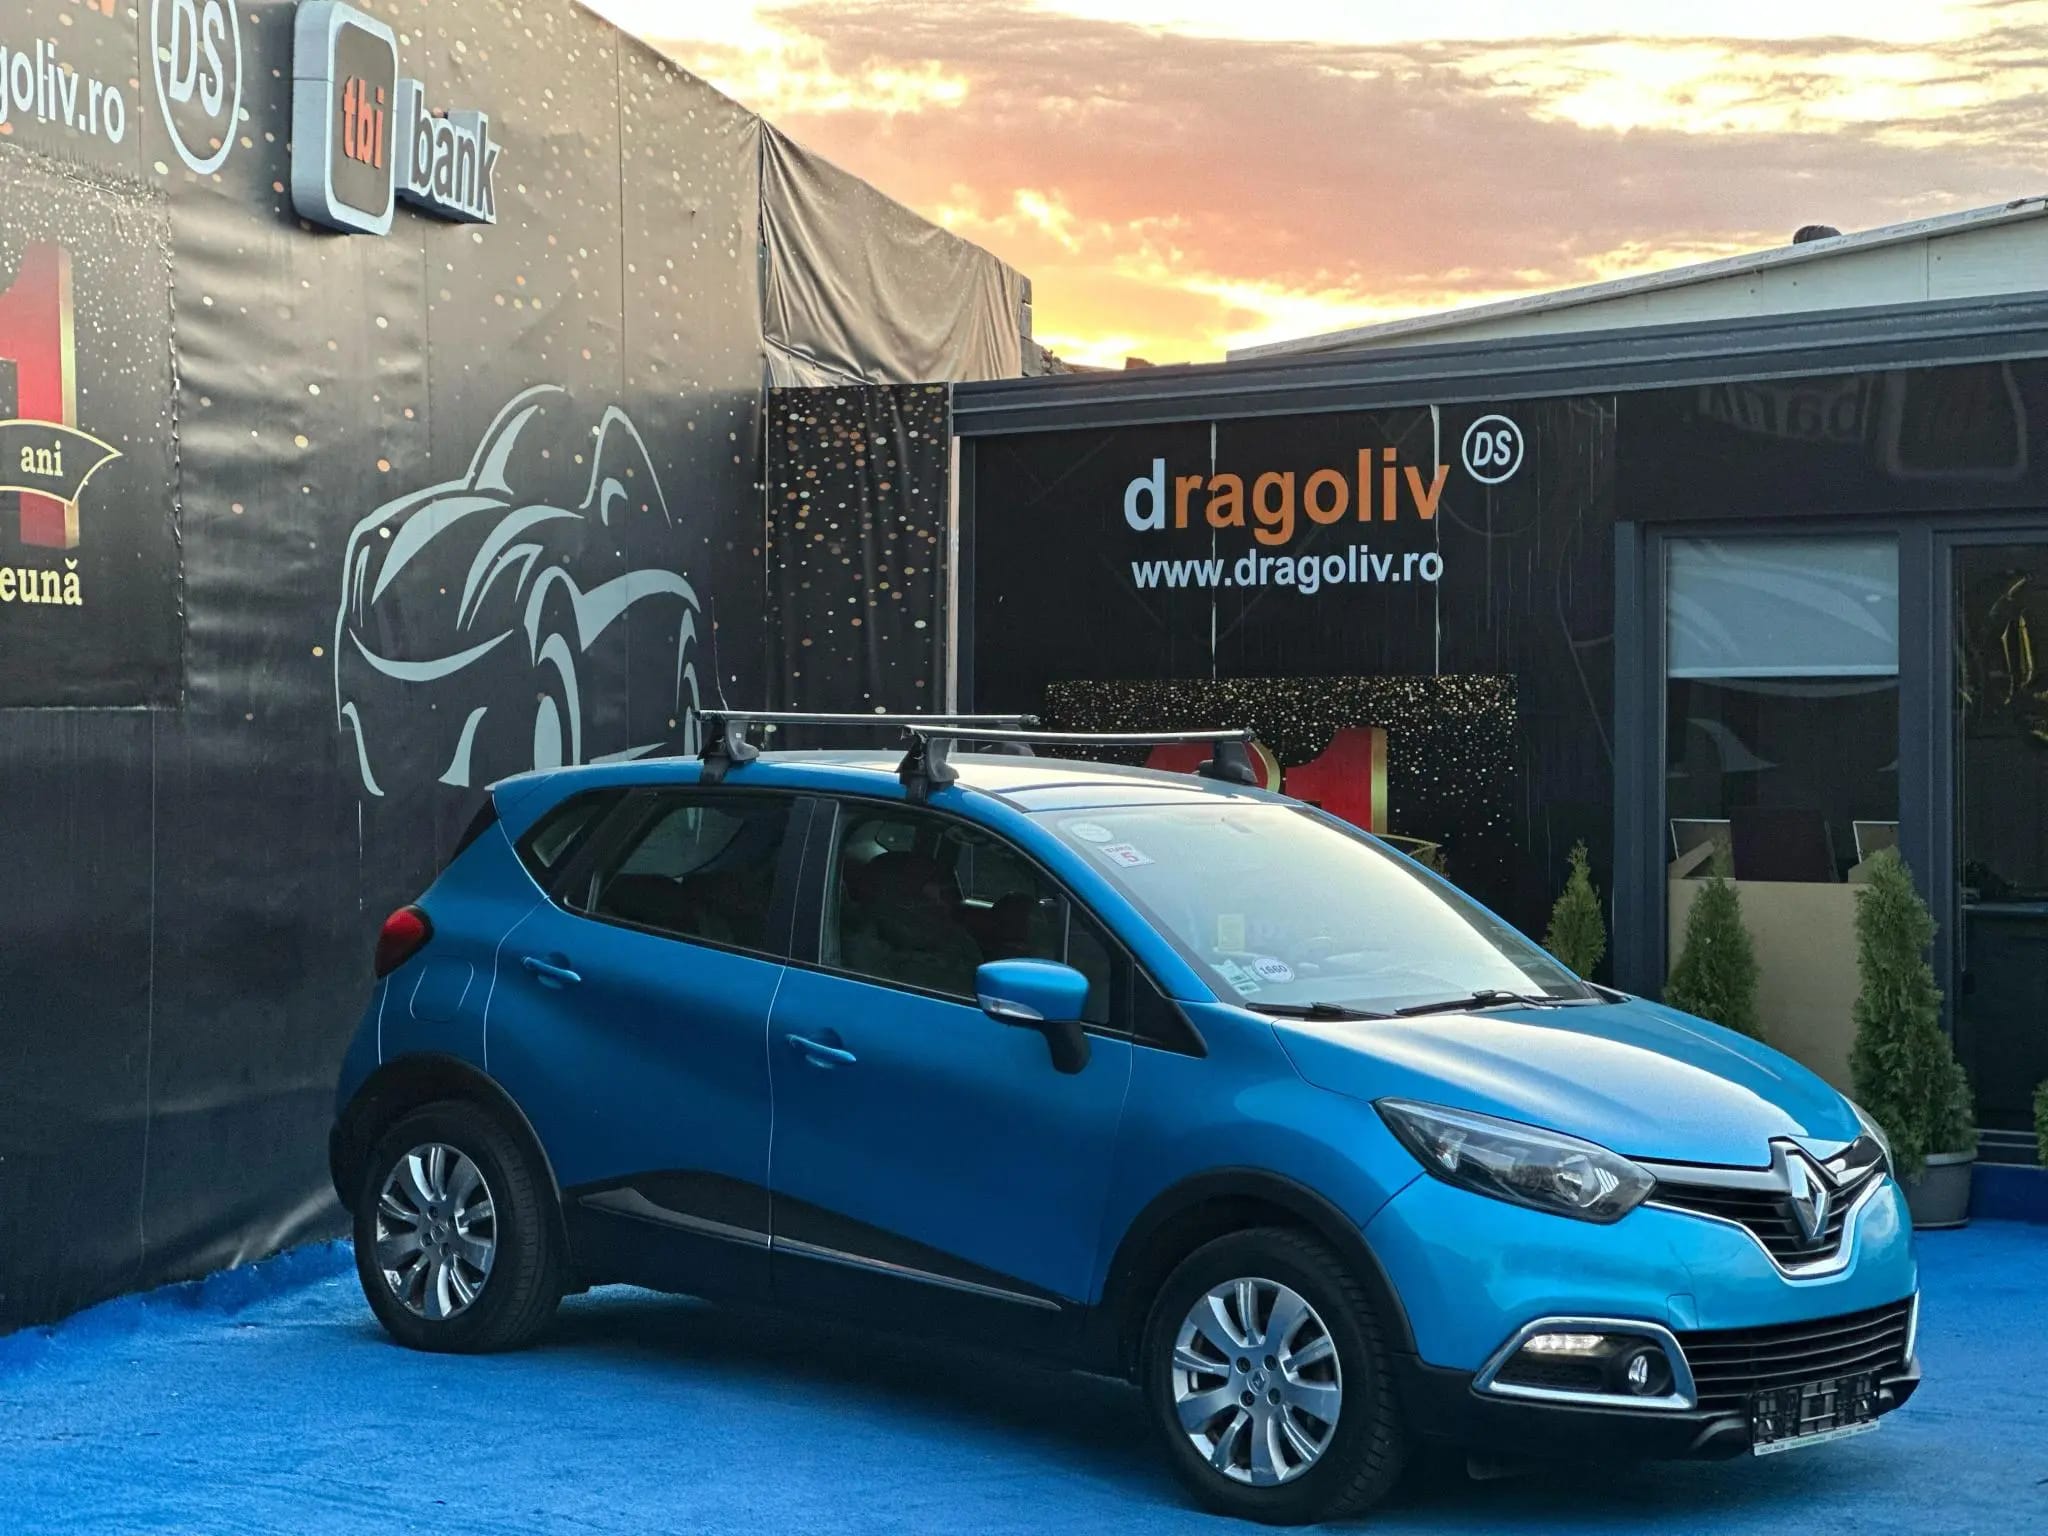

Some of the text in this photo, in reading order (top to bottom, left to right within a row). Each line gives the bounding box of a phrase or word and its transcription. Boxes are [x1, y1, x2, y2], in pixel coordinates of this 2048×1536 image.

[169, 0, 225, 117] DS
[343, 74, 500, 222] tbi bank
[21, 440, 63, 477] ani
[1472, 430, 1512, 467] DS
[1123, 447, 1450, 546] dragoliv
[1131, 545, 1444, 595] www.dragoliv.ro
